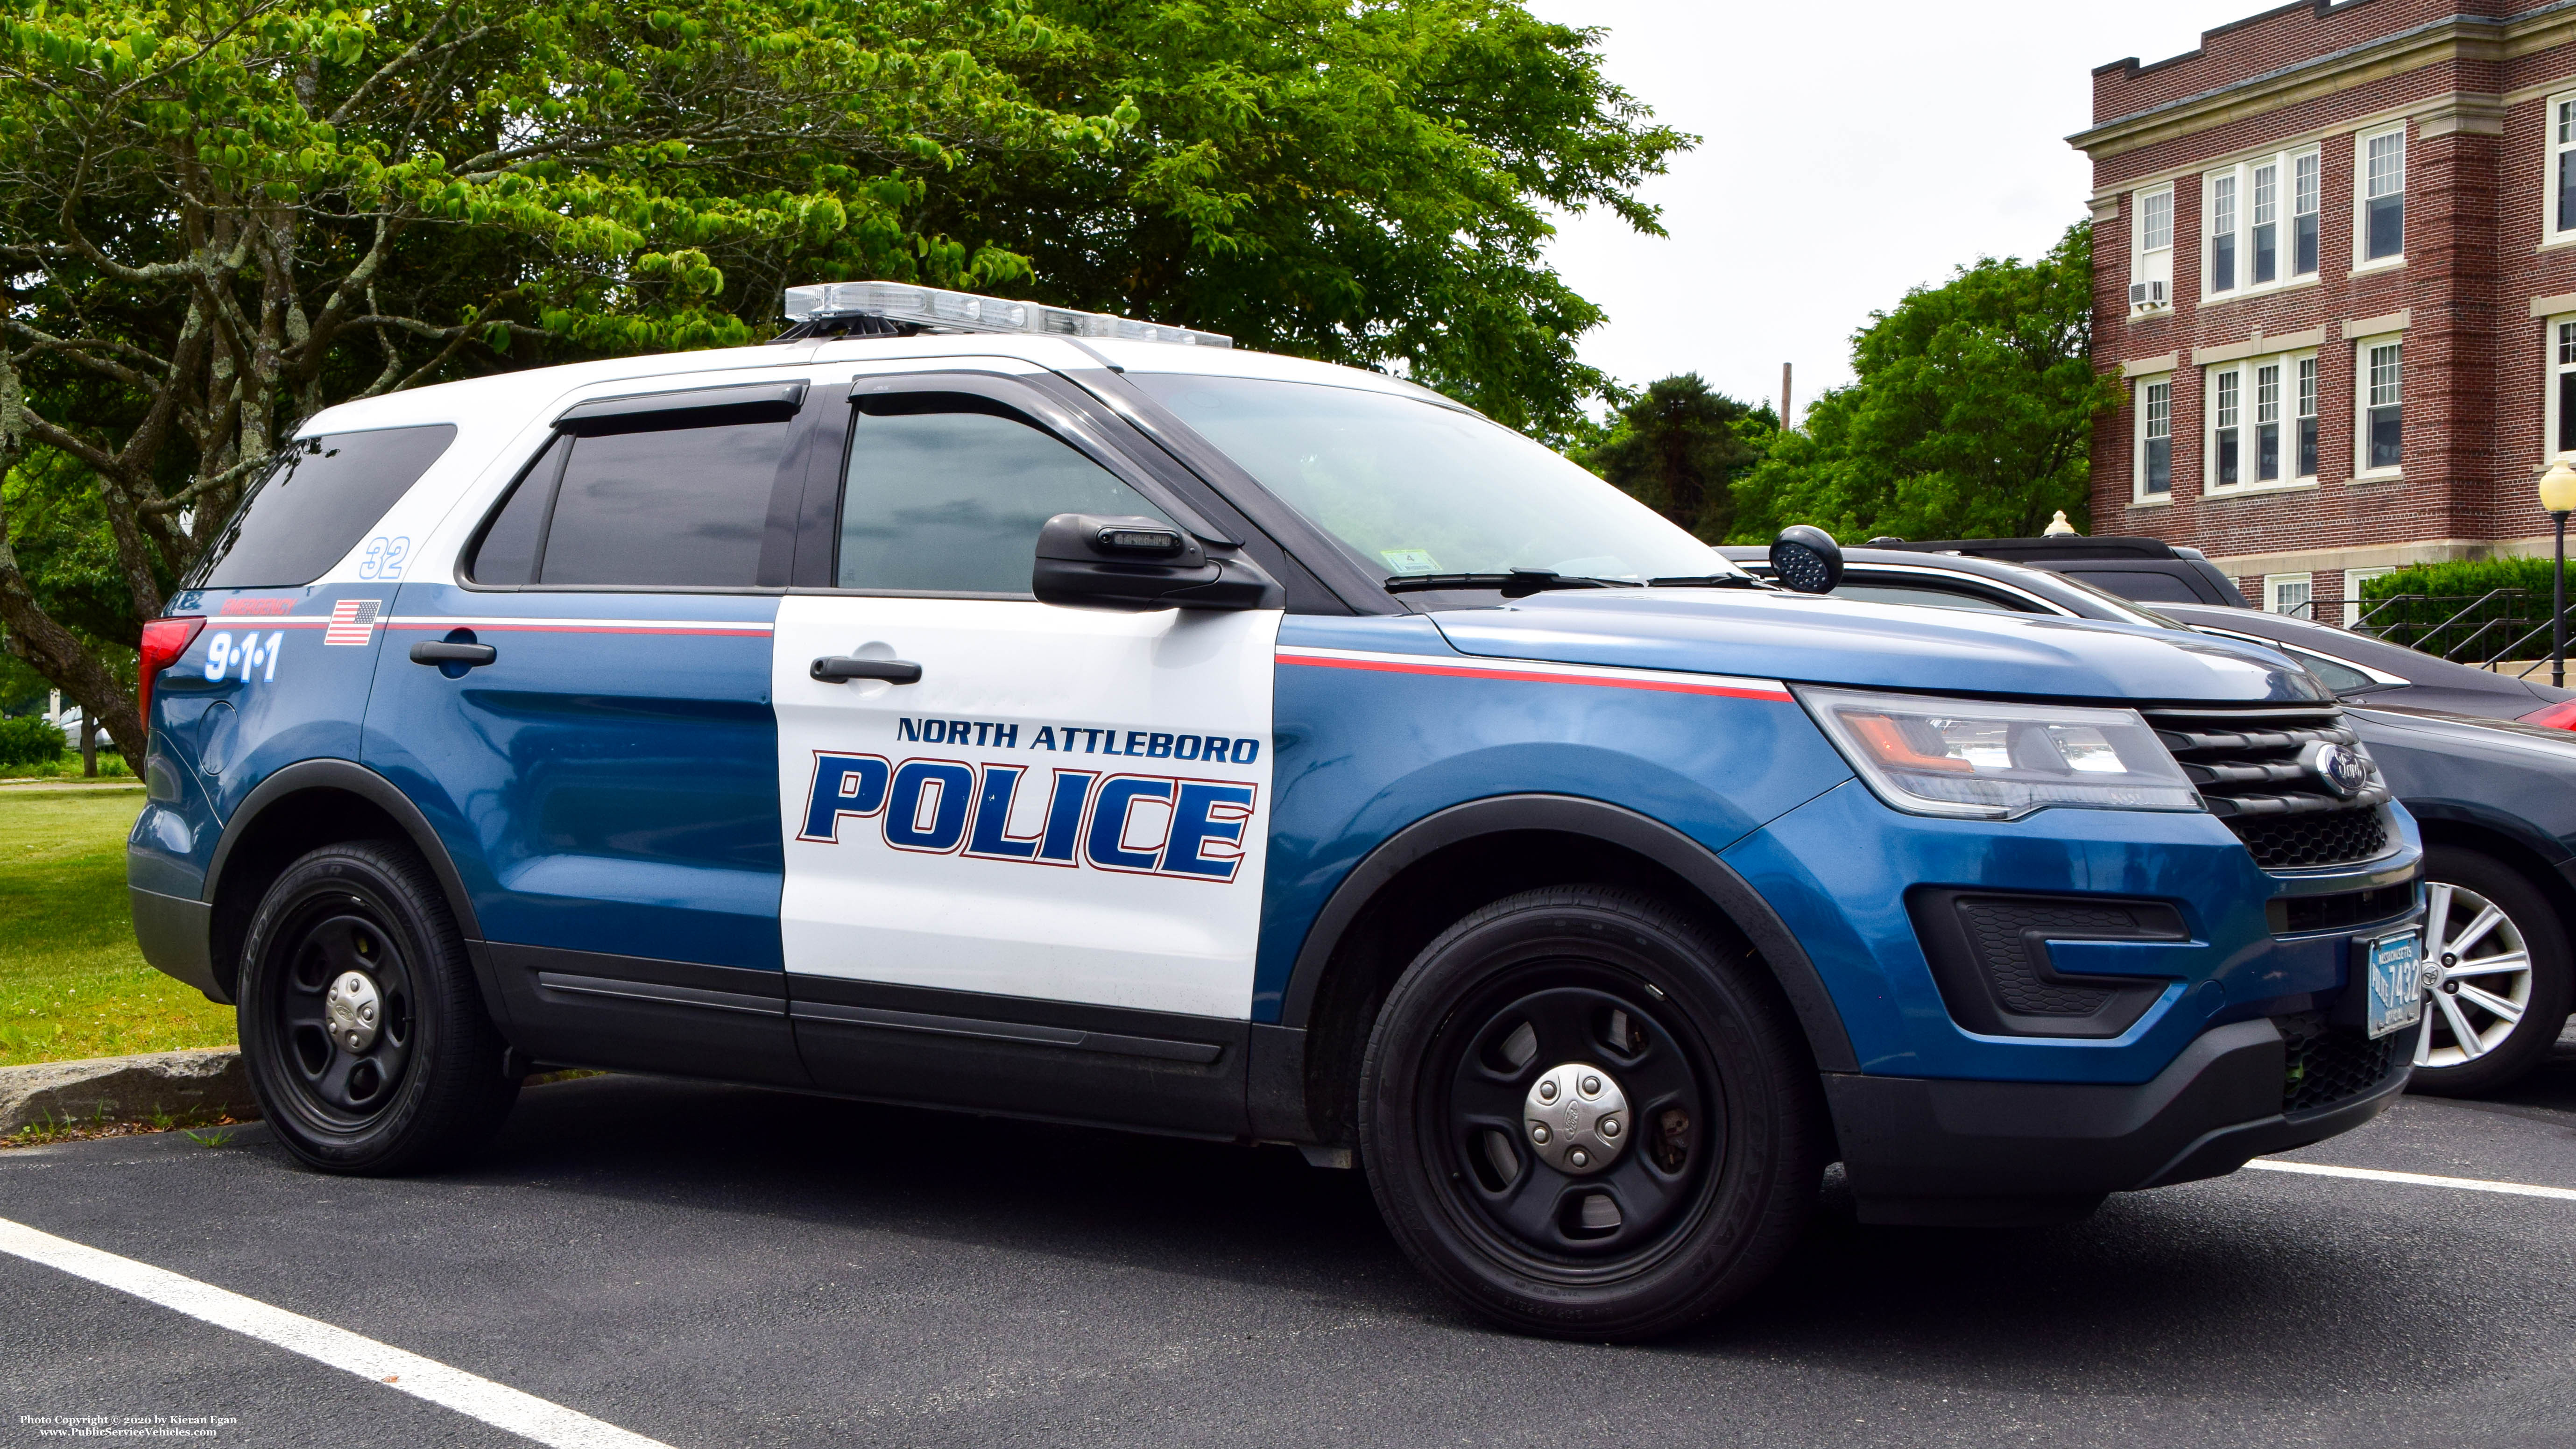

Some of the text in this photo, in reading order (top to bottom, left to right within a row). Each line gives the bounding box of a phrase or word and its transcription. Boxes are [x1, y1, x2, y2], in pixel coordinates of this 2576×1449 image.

[359, 536, 410, 580] 32
[220, 598, 299, 615] EMERGENCY
[896, 717, 1260, 765] NORTH ATTLEBORO
[795, 749, 1258, 884] POLICE
[2389, 959, 2420, 1009] 7432
